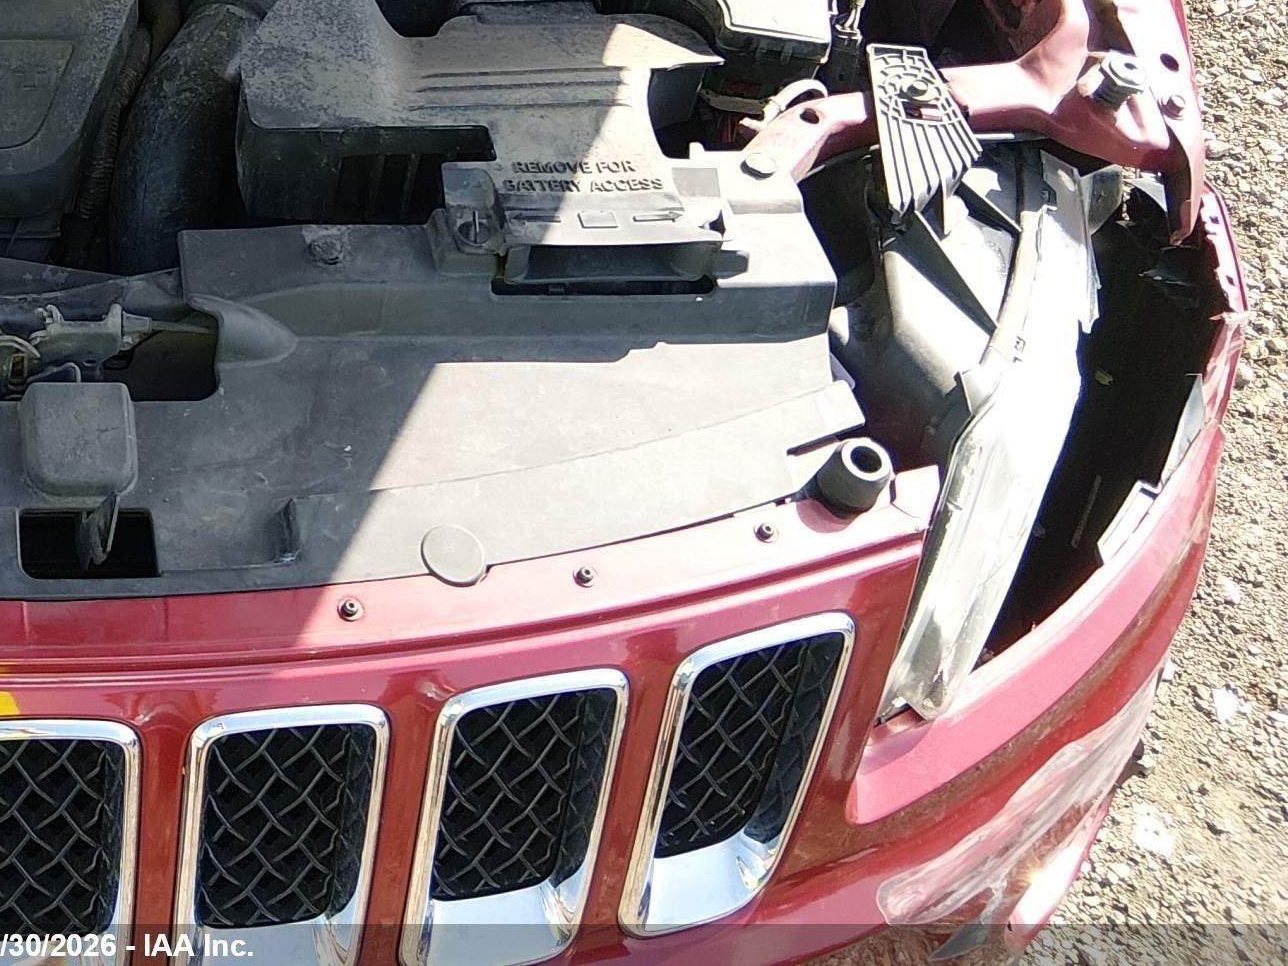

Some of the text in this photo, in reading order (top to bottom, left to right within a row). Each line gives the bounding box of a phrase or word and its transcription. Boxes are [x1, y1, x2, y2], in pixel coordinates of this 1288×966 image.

[511, 160, 637, 174] REMOVE FOR
[503, 178, 665, 192] BATTERY ACCESS
